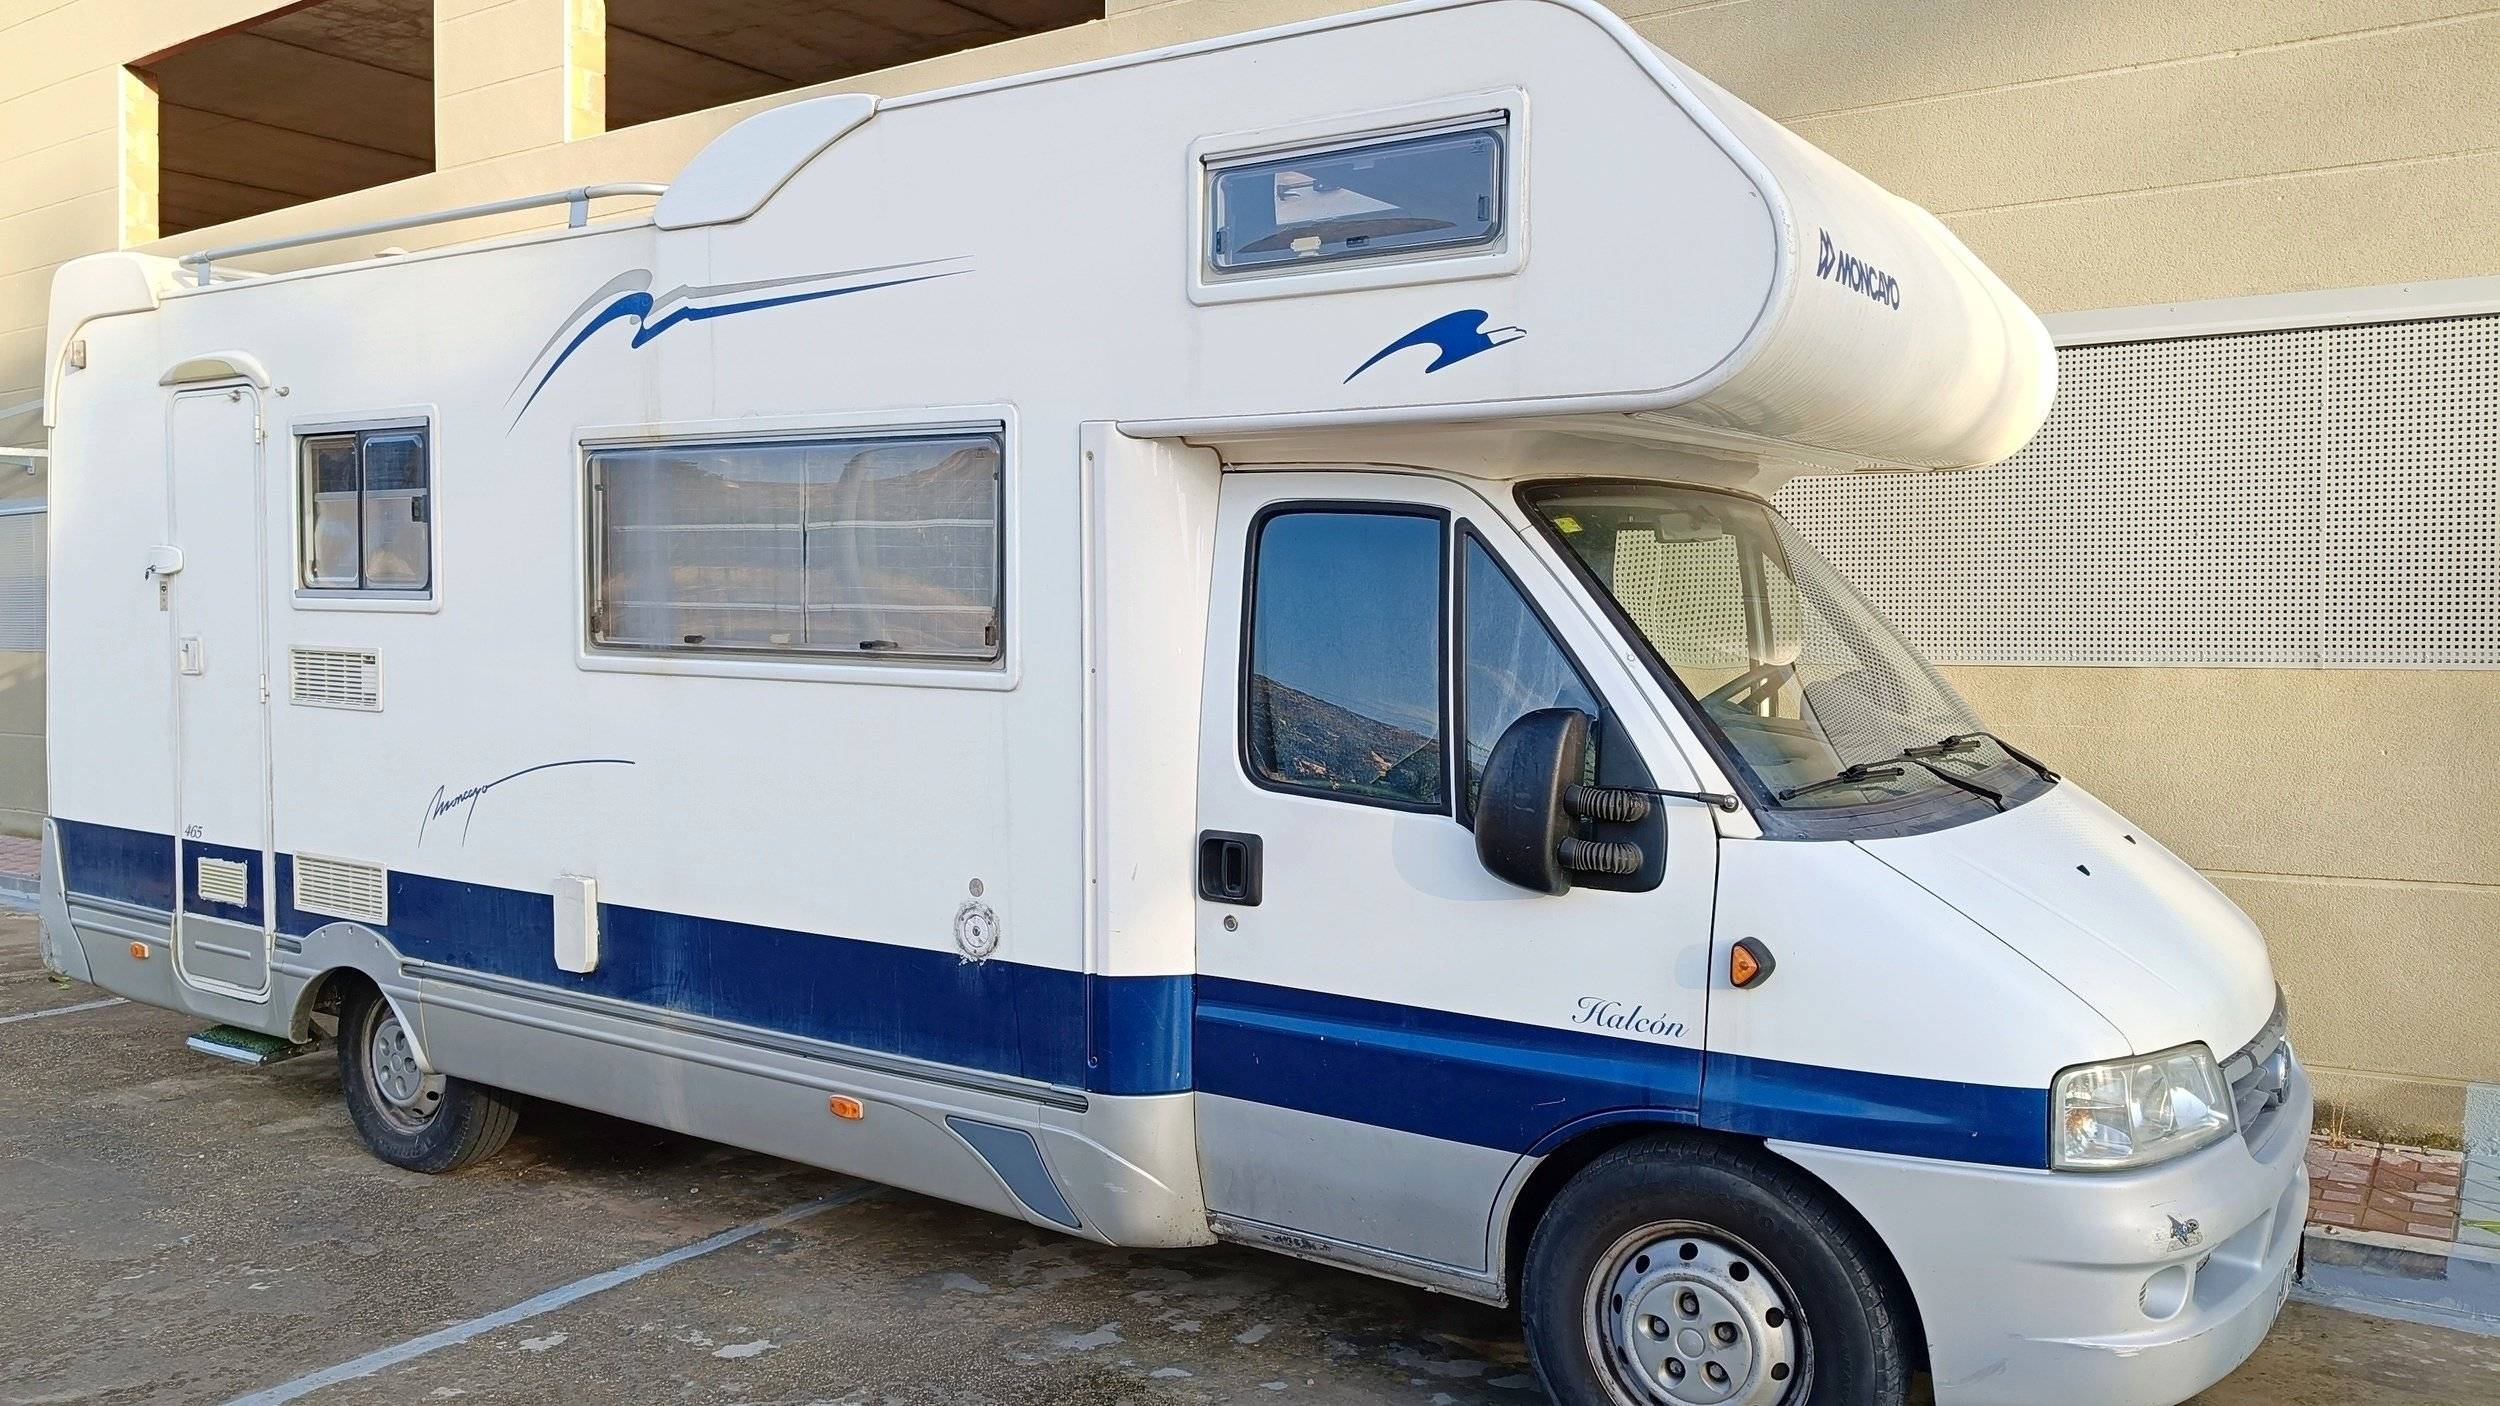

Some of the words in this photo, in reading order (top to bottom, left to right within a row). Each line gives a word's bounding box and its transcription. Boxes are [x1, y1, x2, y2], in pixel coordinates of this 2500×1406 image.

[1835, 249, 1900, 311] MONCAYO
[185, 824, 203, 839] 465
[1571, 996, 1690, 1038] Halcón
